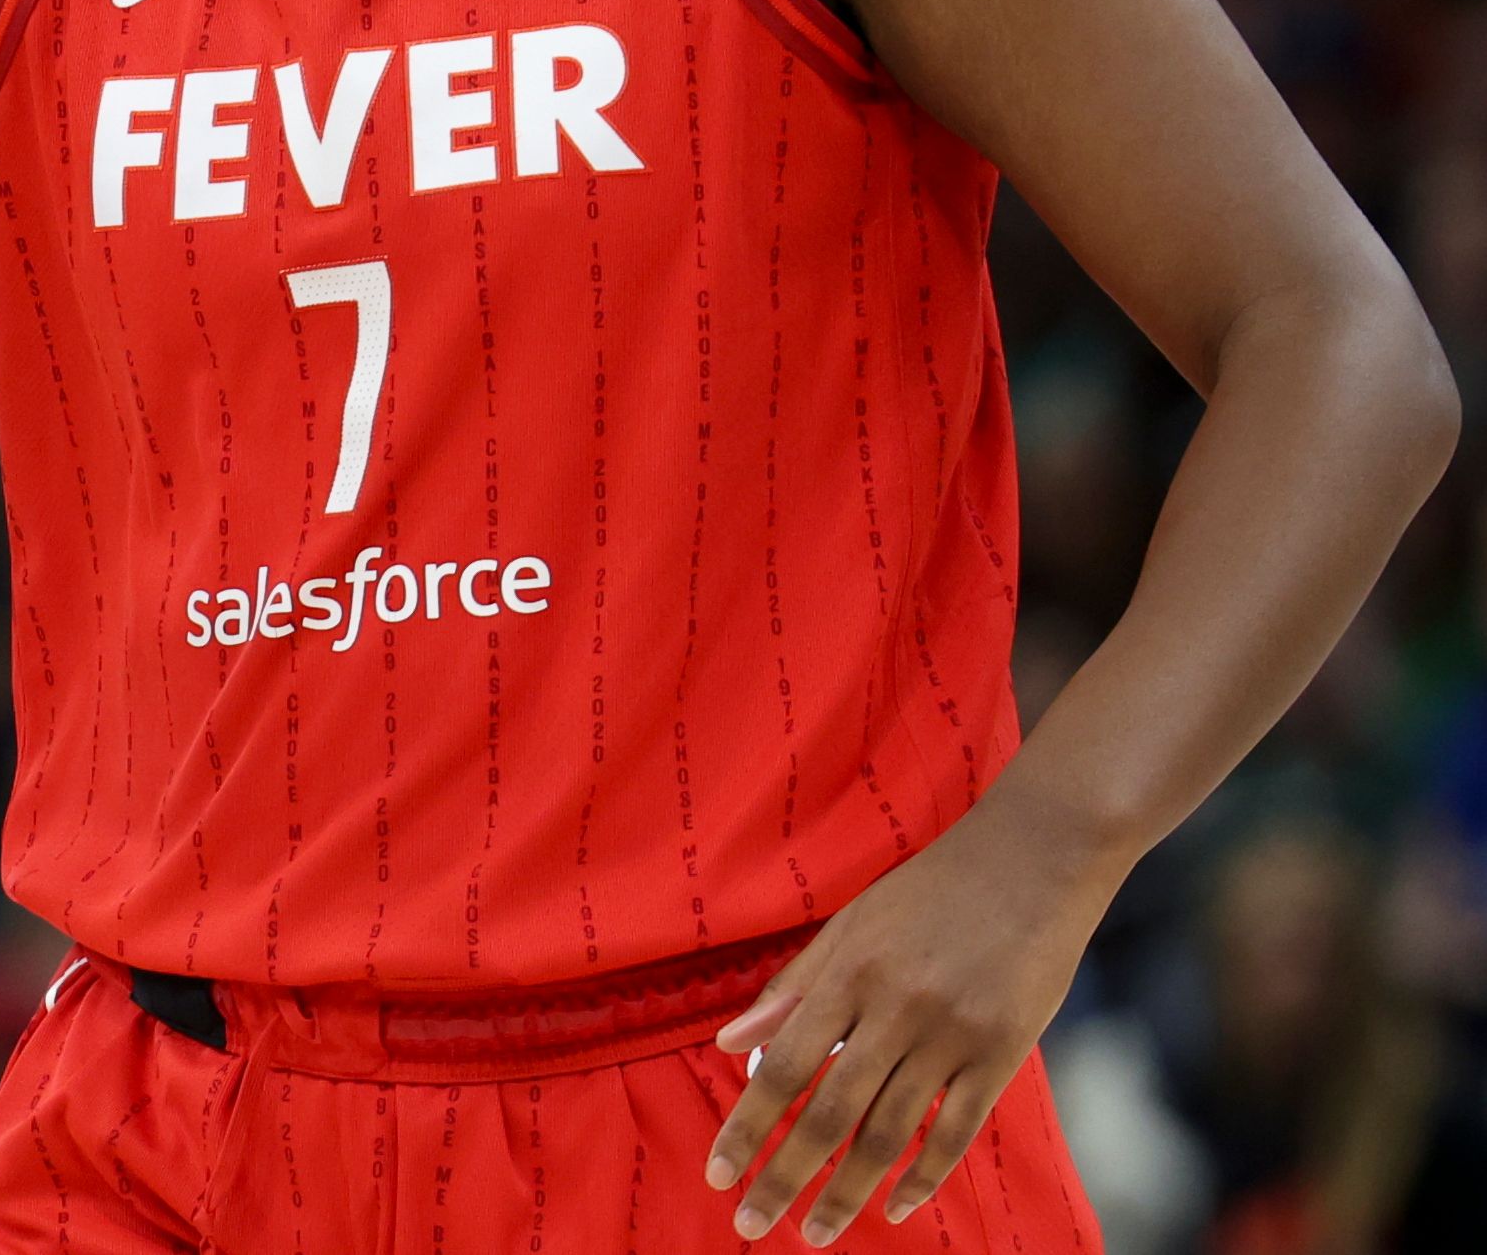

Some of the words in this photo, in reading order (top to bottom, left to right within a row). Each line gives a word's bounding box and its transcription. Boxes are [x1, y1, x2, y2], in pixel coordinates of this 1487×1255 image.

[93, 23, 649, 231] FEVER
[685, 44, 707, 270] BASKETBALL
[774, 118, 788, 204] 1972
[365, 156, 383, 245] 2012
[473, 195, 497, 418] BASKETBALL
[590, 241, 605, 329] 1972
[850, 208, 867, 318] CHOSE
[15, 236, 79, 448] BASKETBALL
[696, 290, 711, 402] CHOSE
[854, 336, 870, 379] ME
[283, 258, 391, 515] 7
[302, 400, 316, 442] ME
[383, 373, 396, 461] 1972
[594, 350, 606, 437] 1999
[218, 388, 233, 475] 2020
[697, 421, 711, 463] ME
[484, 438, 499, 550] CHOSE
[593, 457, 607, 546] 2009
[854, 397, 888, 616] BASKETBALL
[185, 546, 552, 651] salesforce
[592, 568, 607, 654] 2012
[765, 547, 783, 636] 2020
[384, 691, 398, 778] 2012
[591, 675, 605, 763] 2020
[777, 657, 794, 735] 1972
[286, 693, 300, 804] CHOSE
[485, 631, 501, 850] BASKETBALL
[674, 721, 694, 831] CHOSE
[376, 797, 390, 883] 2020
[681, 845, 699, 878] ME
[365, 903, 385, 979] 1972
[465, 862, 483, 969] CHOSE
[579, 886, 599, 962] 1999
[279, 1122, 304, 1209] 2020
[434, 1165, 453, 1207] ME
[529, 1165, 546, 1254] 2020
